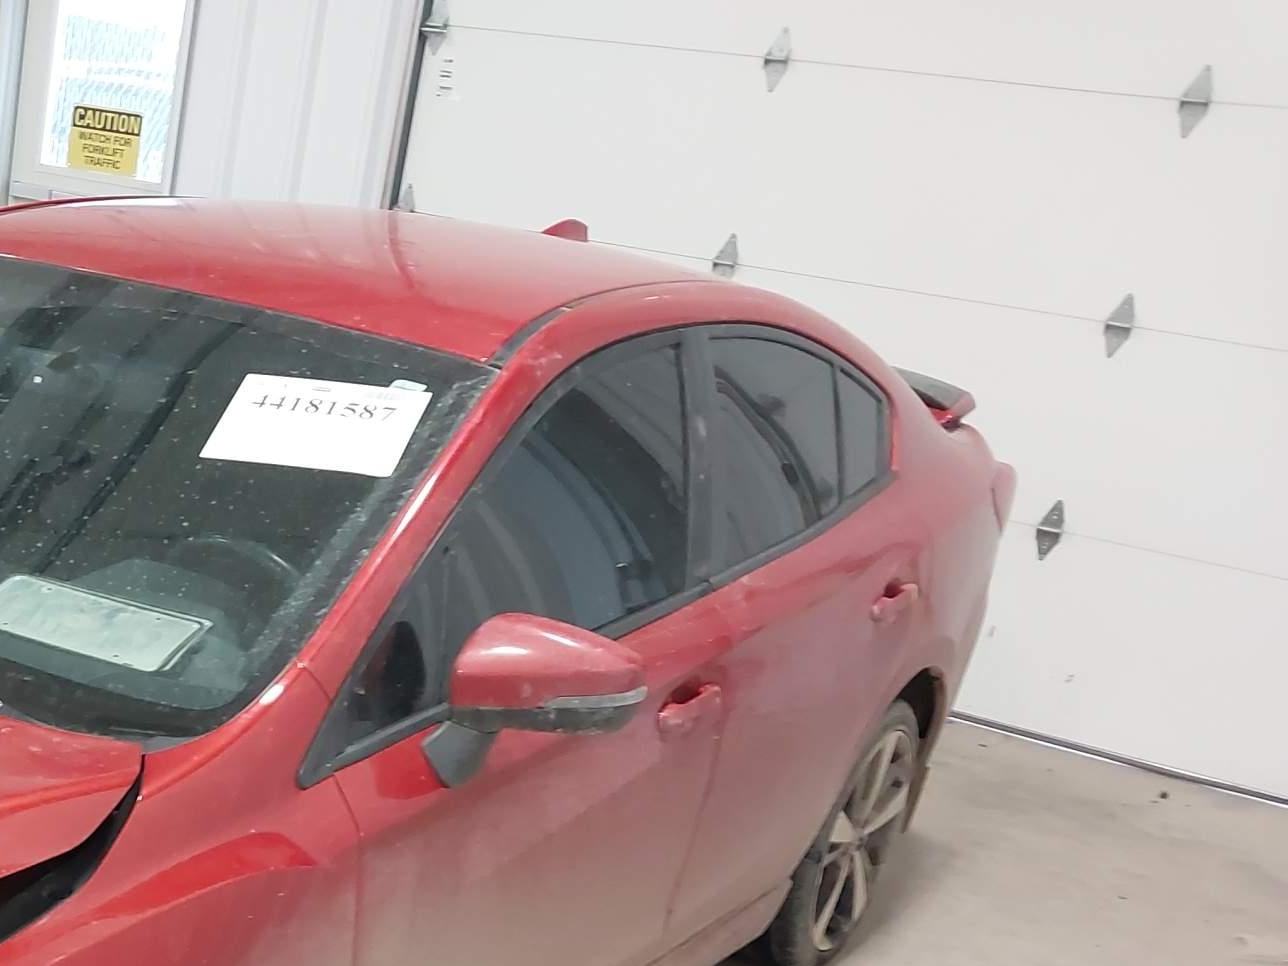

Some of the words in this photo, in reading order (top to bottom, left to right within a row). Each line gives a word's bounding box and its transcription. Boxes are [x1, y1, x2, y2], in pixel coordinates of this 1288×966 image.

[74, 108, 141, 134] CAUTION
[78, 131, 112, 144] WATCH
[113, 135, 133, 148] FOR
[82, 143, 126, 158] FORKLIFT
[83, 155, 121, 170] TRAFFIC
[251, 394, 398, 421] 44181587
